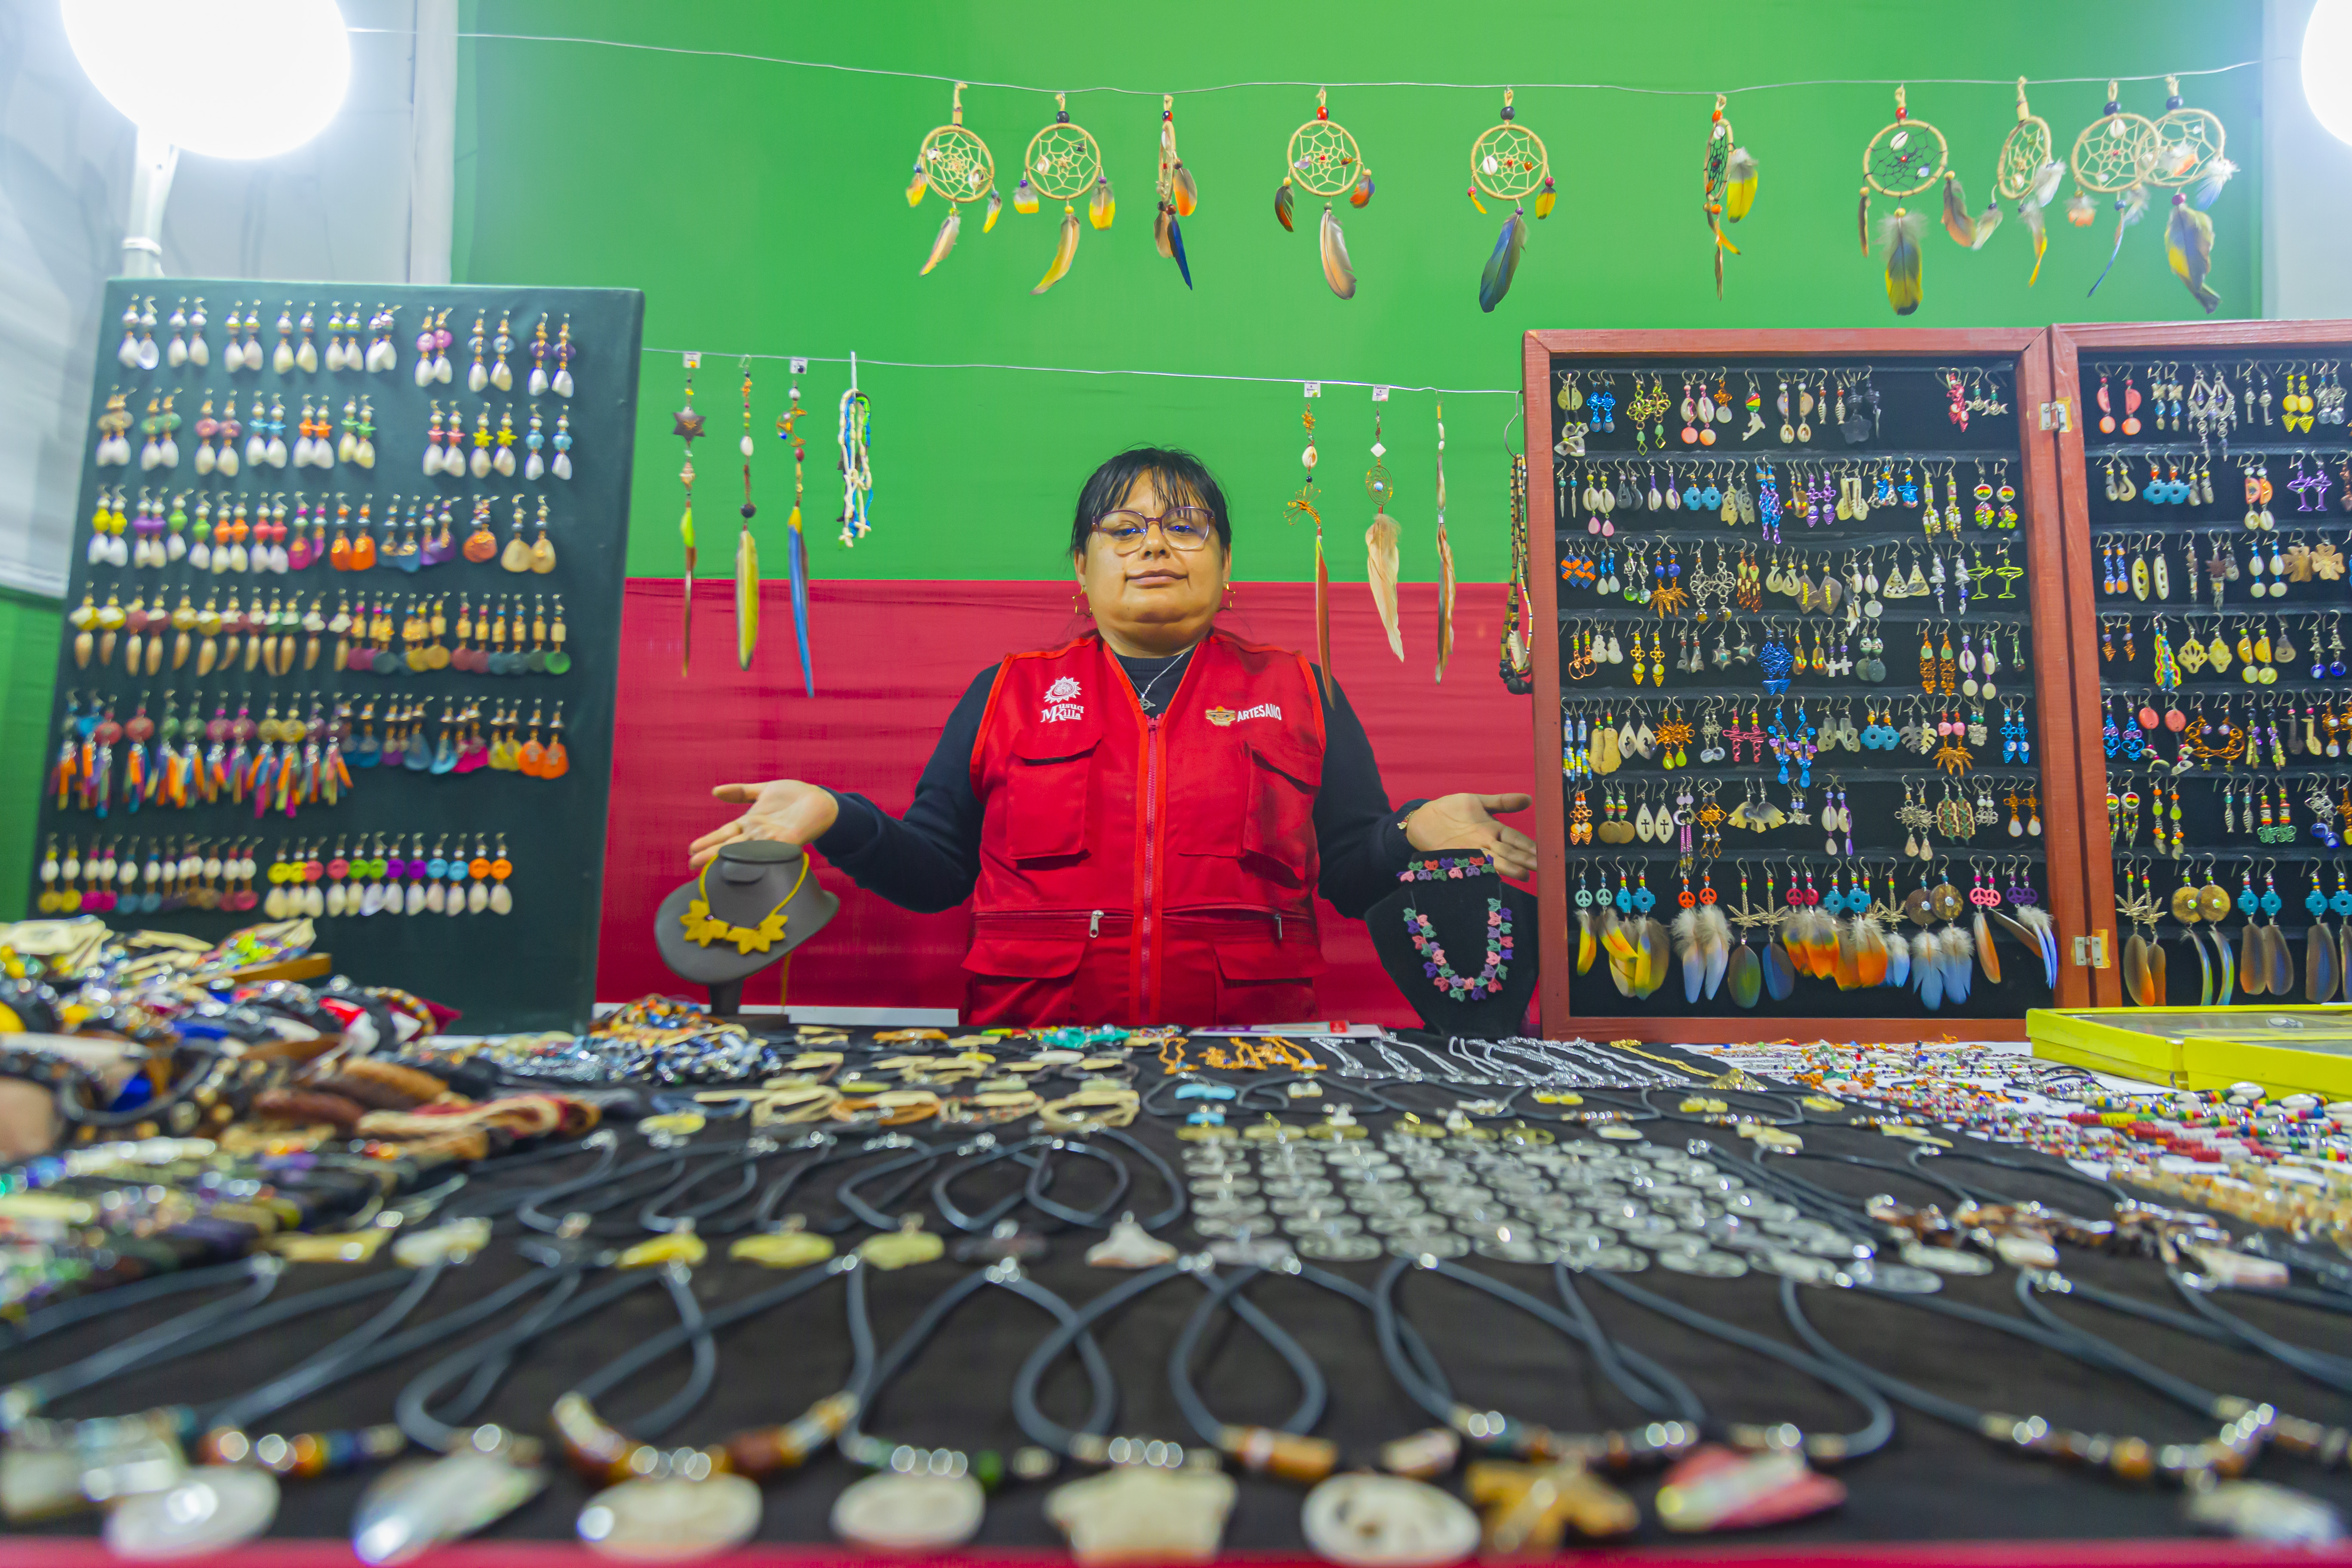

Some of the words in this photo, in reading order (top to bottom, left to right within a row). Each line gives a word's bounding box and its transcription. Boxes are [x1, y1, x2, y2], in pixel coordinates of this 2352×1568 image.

[1040, 704, 1084, 723] Musuq
[1054, 708, 1081, 721] Killa
[1237, 704, 1282, 722] ARTESANO
